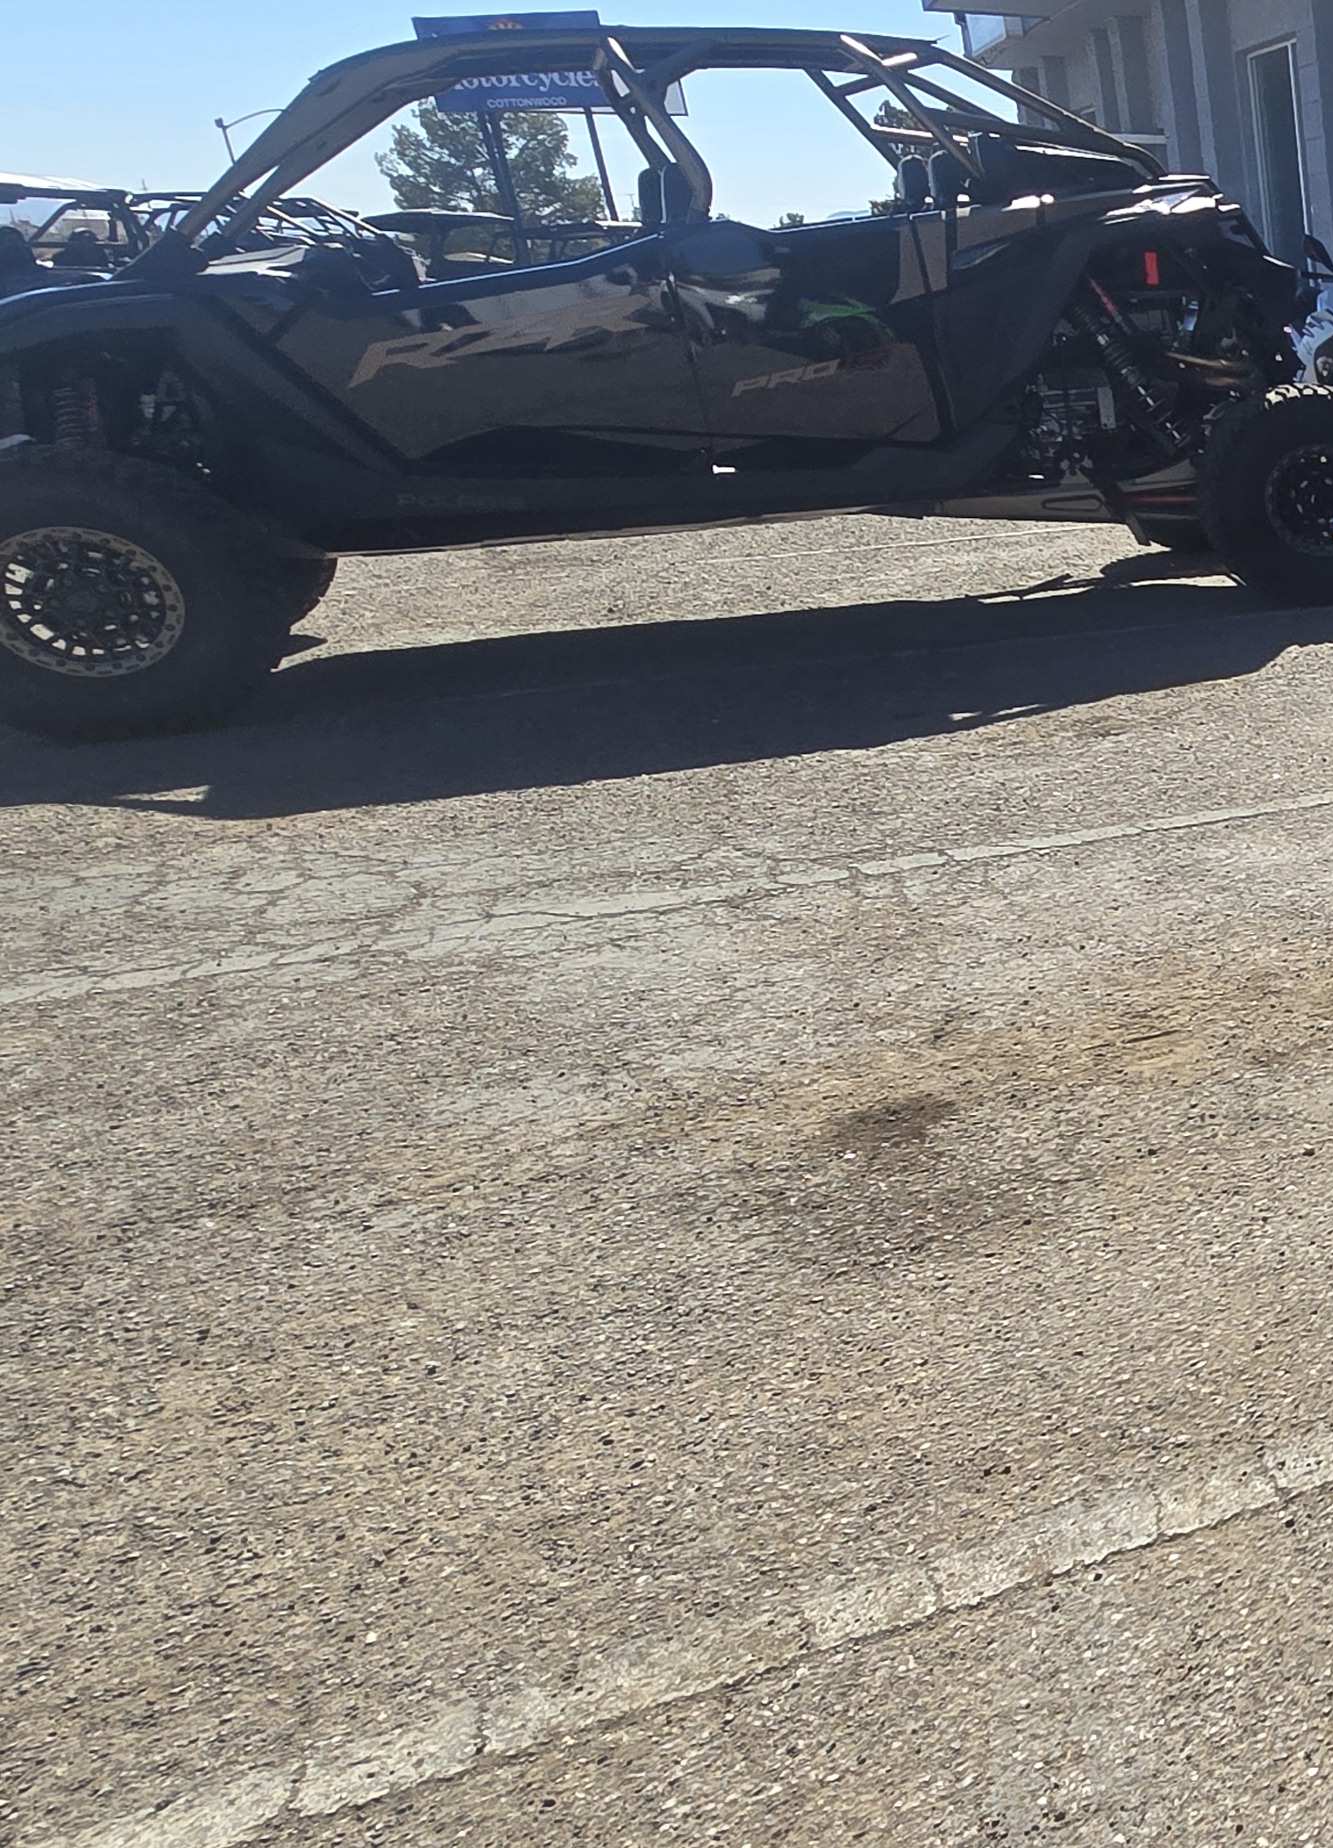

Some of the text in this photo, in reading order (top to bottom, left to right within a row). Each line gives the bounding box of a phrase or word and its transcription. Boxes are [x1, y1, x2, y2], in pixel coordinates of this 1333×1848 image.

[454, 70, 600, 92] otorcycle
[486, 96, 568, 109] COTTONWOOD
[731, 358, 840, 398] PRO
